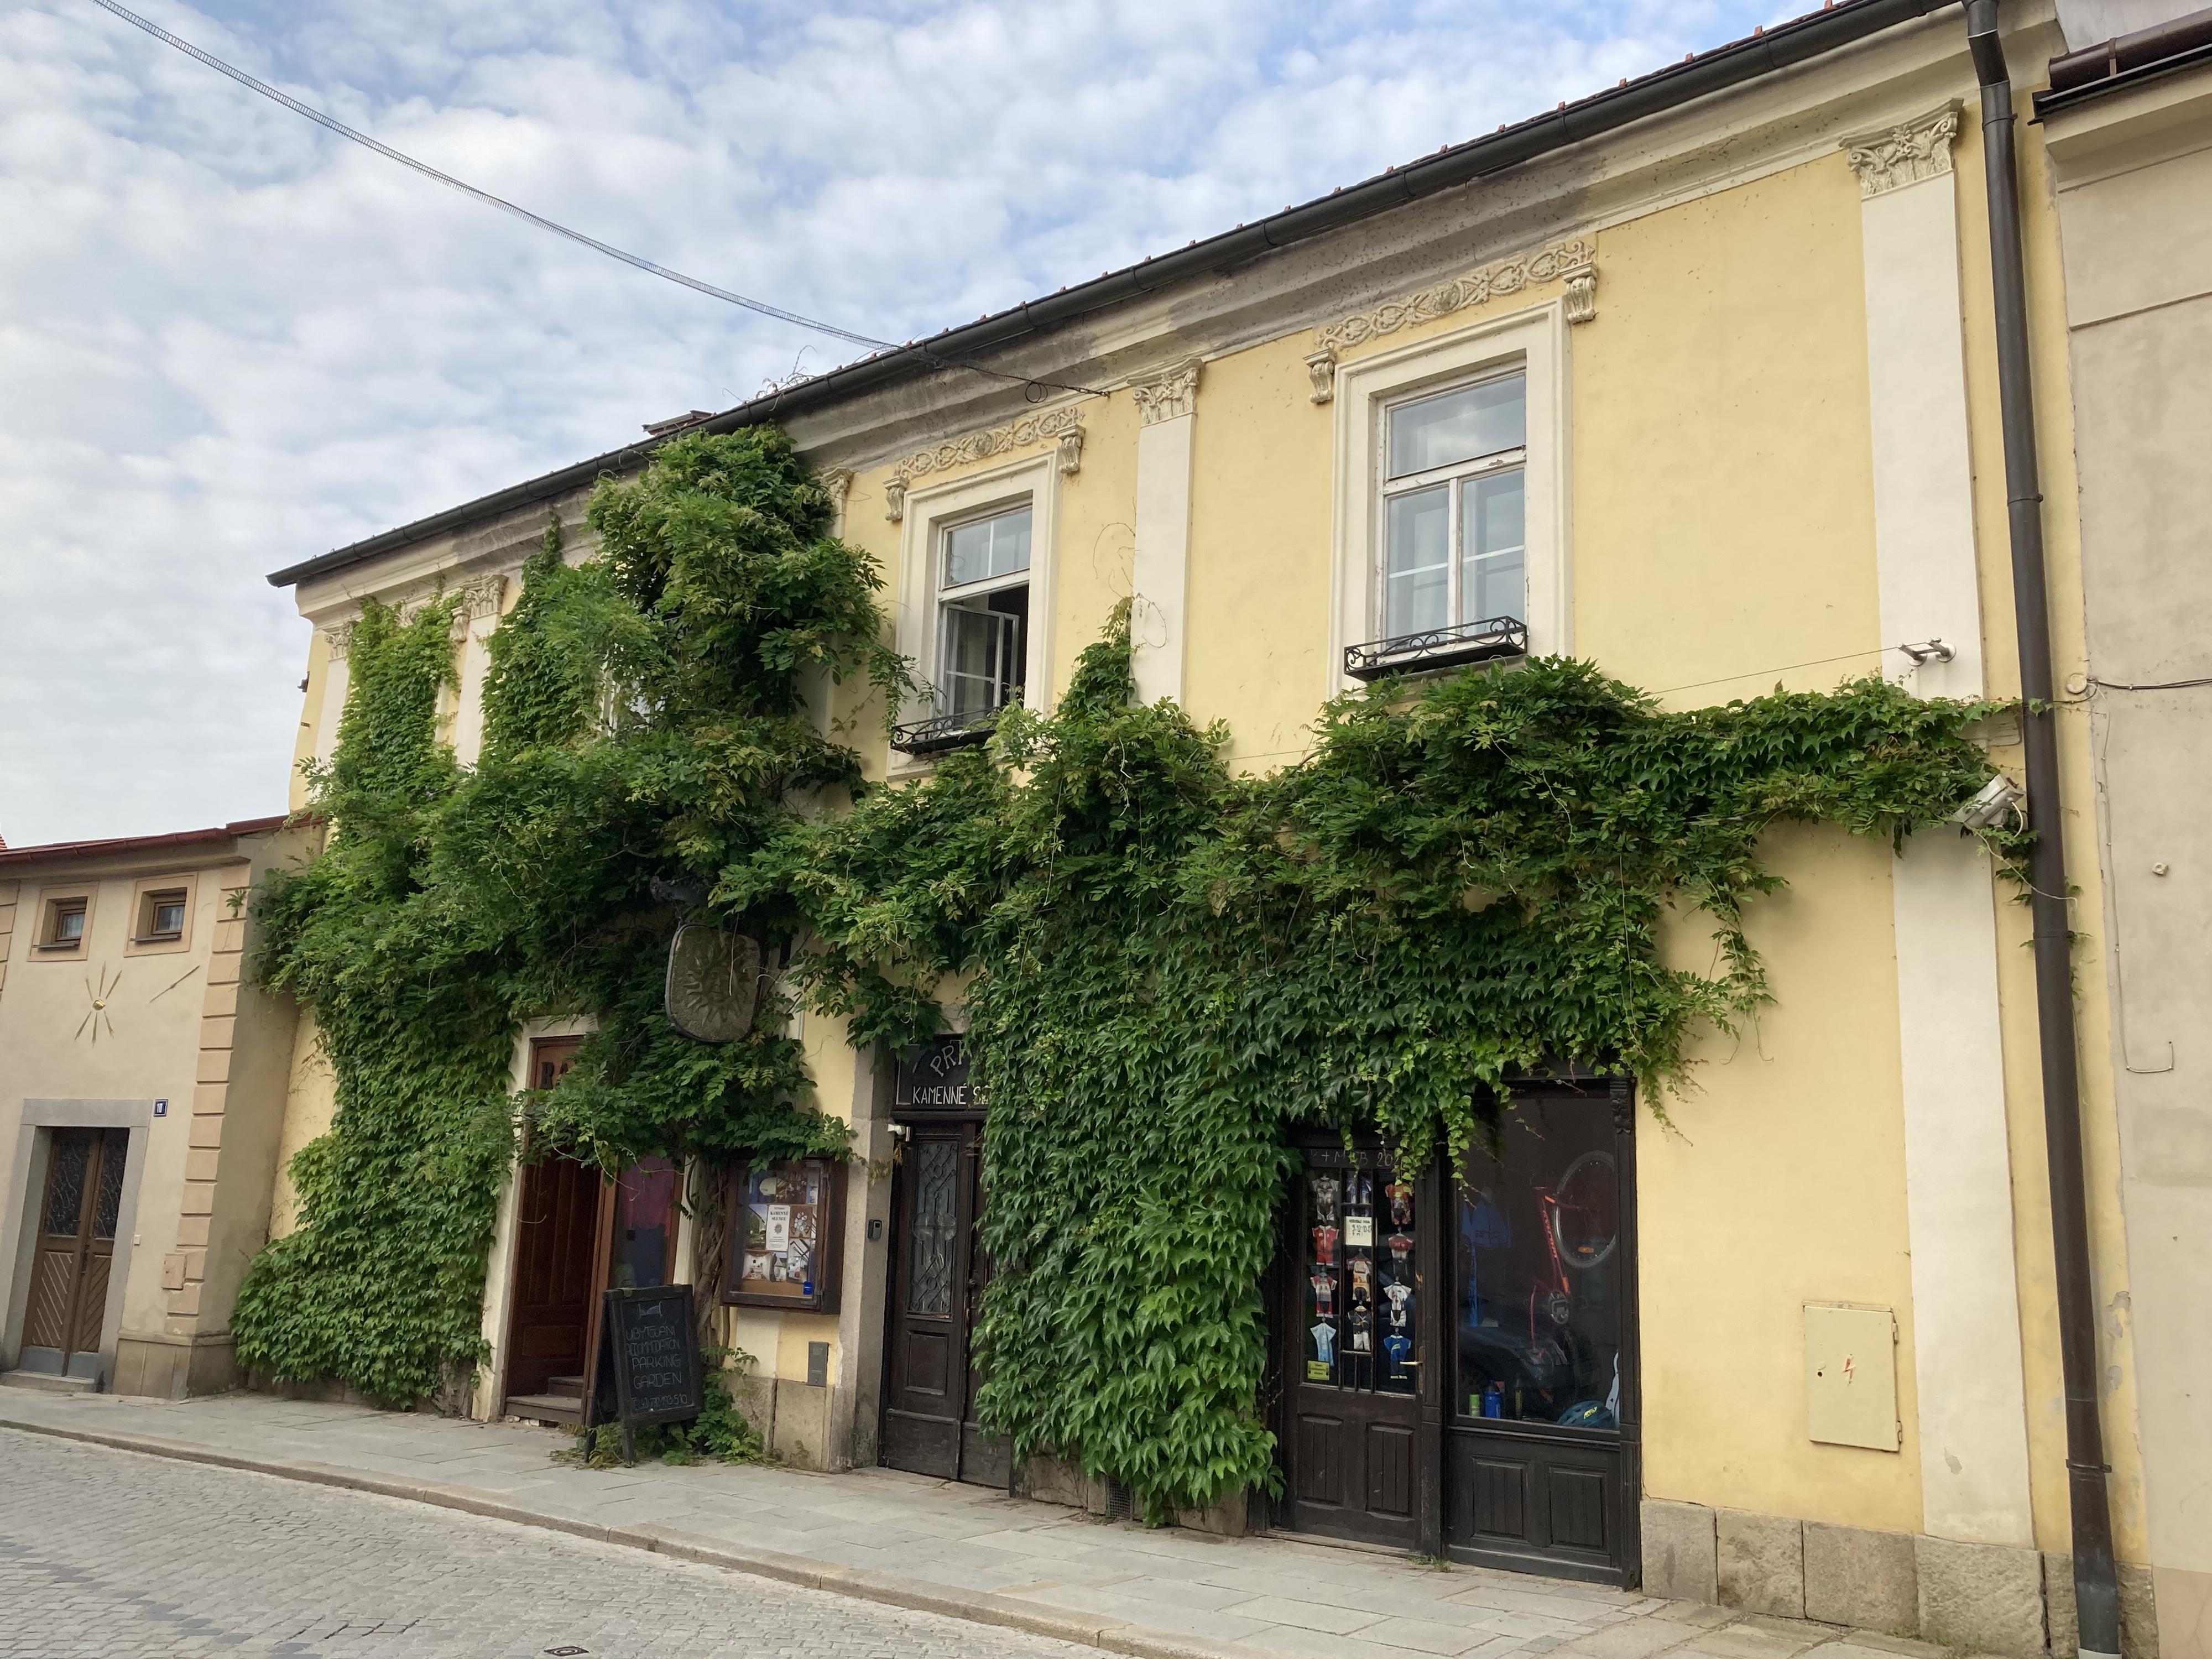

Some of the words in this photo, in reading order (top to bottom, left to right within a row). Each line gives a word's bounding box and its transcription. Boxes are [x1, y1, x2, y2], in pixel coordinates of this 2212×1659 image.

[912, 1083, 967, 1104] KAMENNÉ
[632, 1354, 681, 1371] PARKING
[633, 1371, 682, 1389] GARDEN
